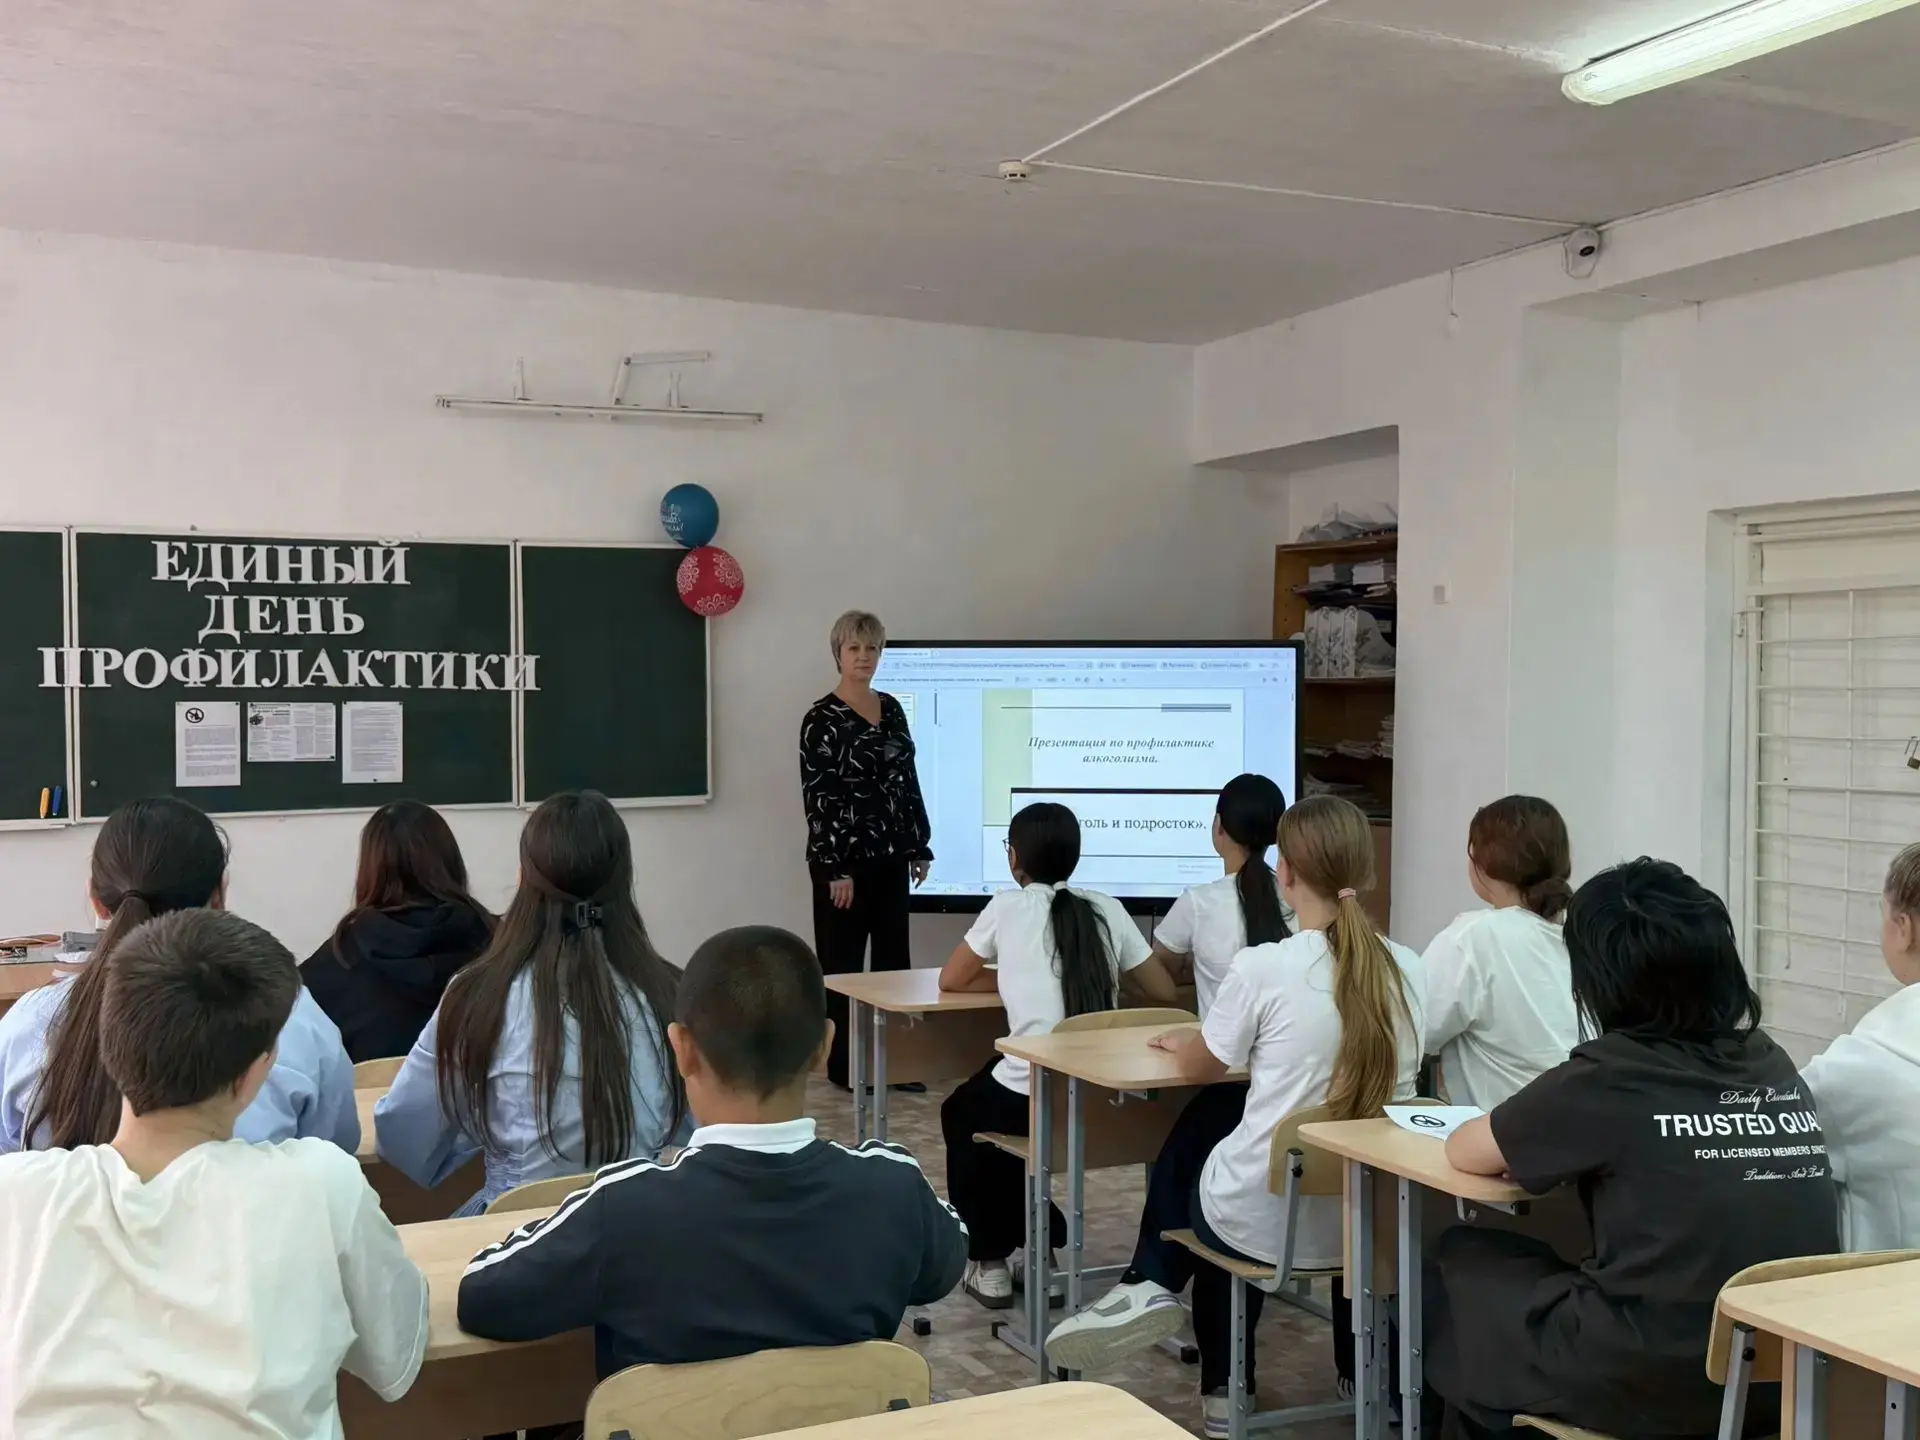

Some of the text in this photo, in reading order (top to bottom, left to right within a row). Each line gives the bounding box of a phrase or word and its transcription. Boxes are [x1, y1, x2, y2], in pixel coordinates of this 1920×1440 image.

[151, 537, 411, 592] ЕДИНЫЙ
[198, 595, 365, 644] ДЕНЬ
[37, 646, 541, 691] ПРОФИЛАКТИКИ
[1028, 737, 1215, 750] Презентация по профилактике
[1082, 754, 1159, 763] алкоголизма.
[1112, 819, 1120, 828] и
[1719, 1088, 1762, 1112] Daily
[1653, 1110, 1822, 1137] TRUSTED QUA
[1694, 1149, 1719, 1159] FOR
[1722, 1148, 1771, 1159] LICENSED
[1771, 1145, 1811, 1157] MEMBERS
